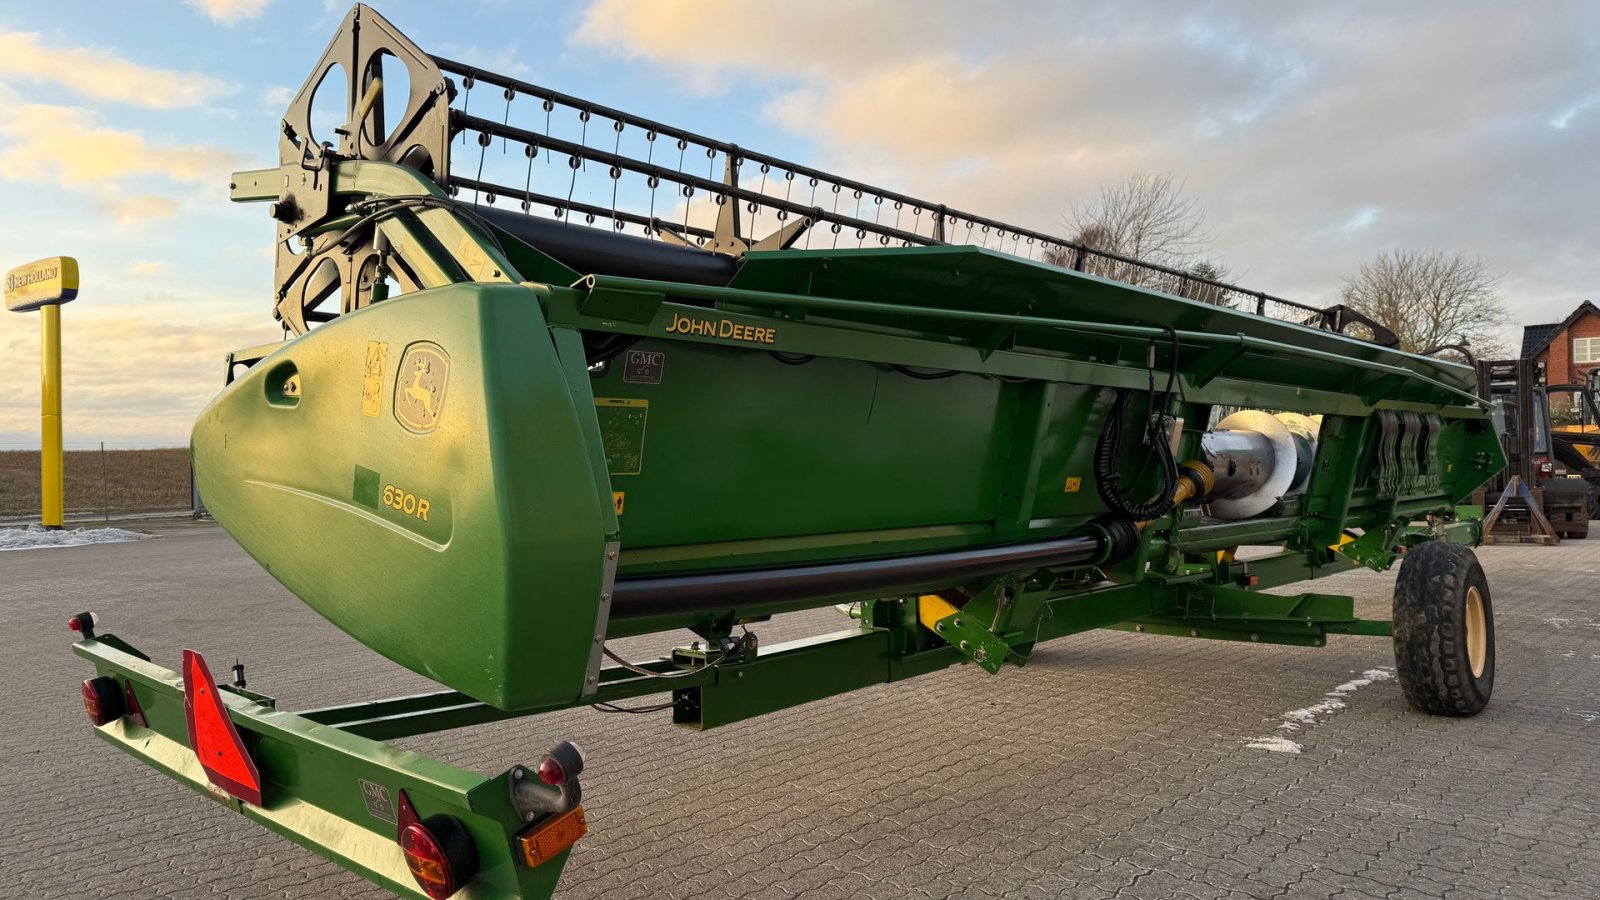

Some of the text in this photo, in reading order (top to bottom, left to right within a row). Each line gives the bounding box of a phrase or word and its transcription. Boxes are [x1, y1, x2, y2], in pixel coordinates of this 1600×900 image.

[28, 267, 58, 284] HOLLAND
[665, 313, 777, 344] JOHN DEERE
[630, 352, 661, 366] GMC
[383, 484, 431, 521] 630R
[363, 782, 388, 801] GMC
